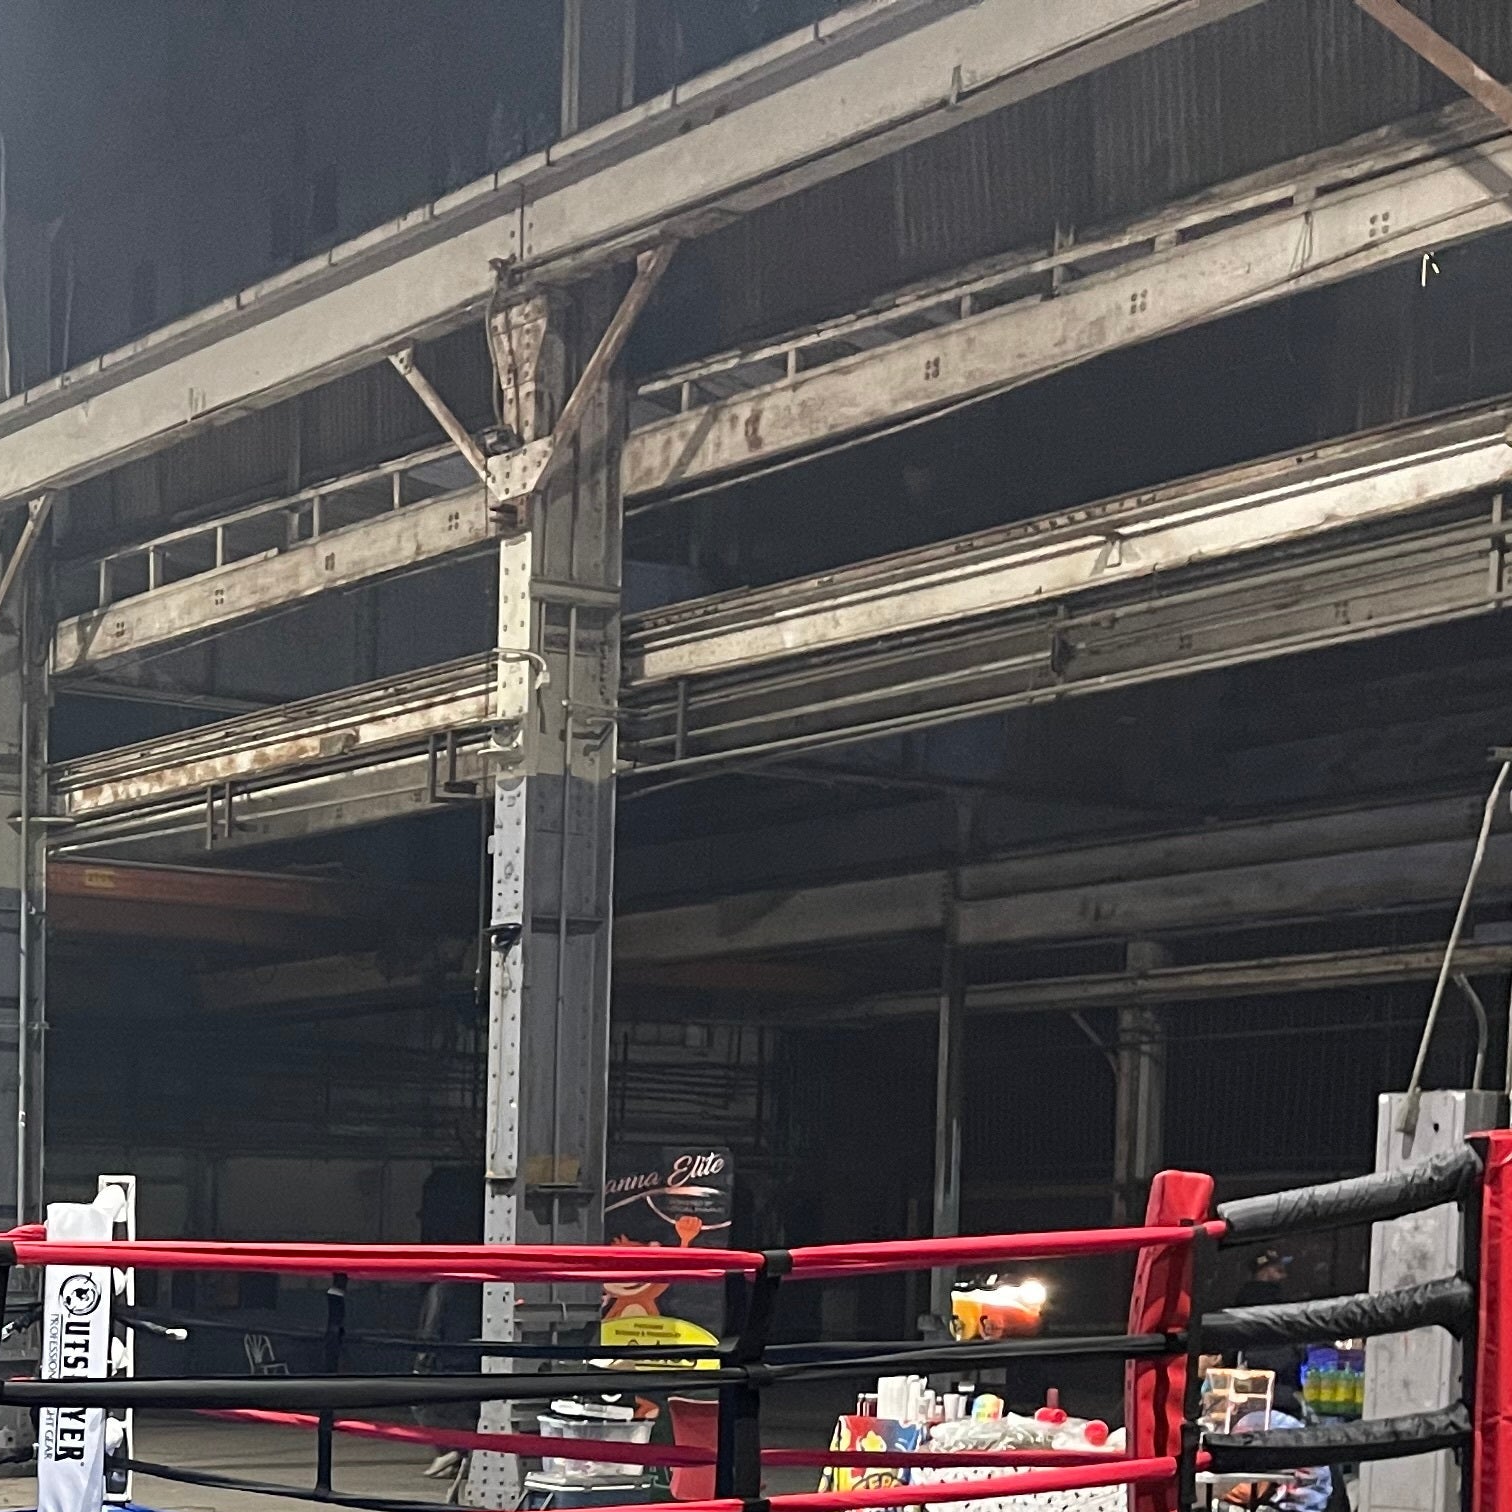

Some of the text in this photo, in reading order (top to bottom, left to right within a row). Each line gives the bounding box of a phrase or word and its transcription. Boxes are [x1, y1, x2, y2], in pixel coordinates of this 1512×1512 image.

[605, 1152, 725, 1194] anna Elite
[54, 1271, 102, 1461] OUTSYER
